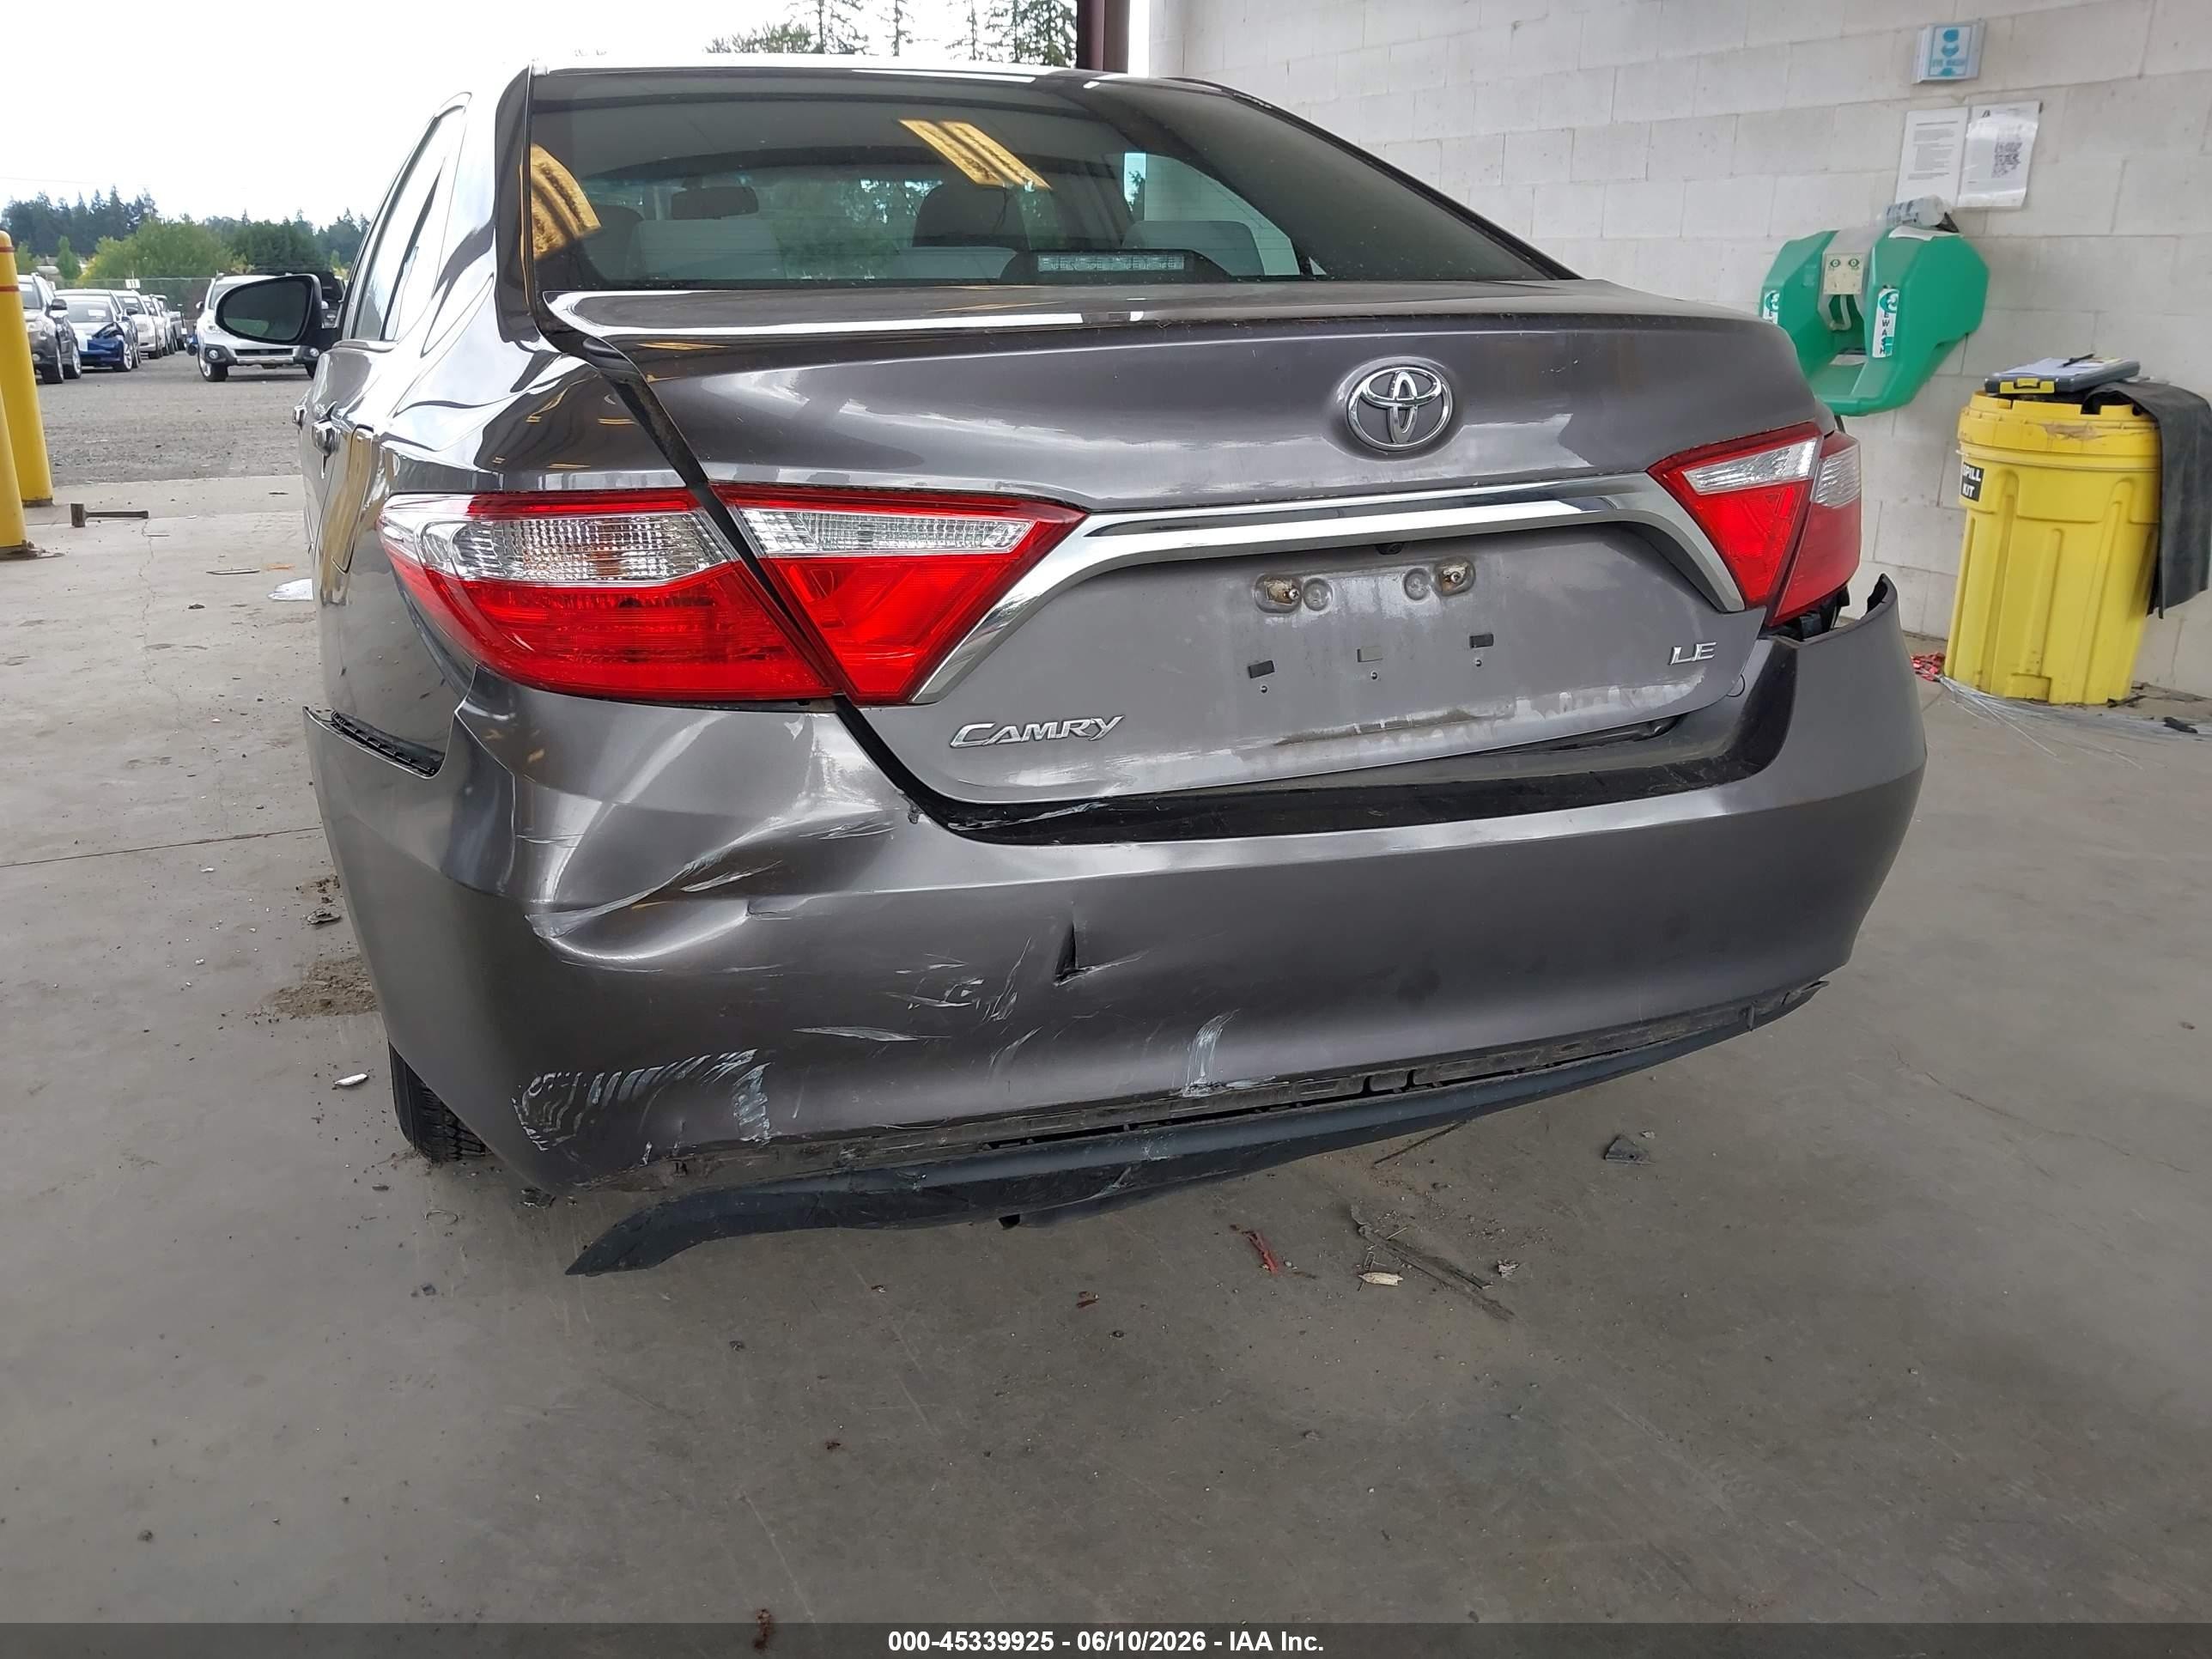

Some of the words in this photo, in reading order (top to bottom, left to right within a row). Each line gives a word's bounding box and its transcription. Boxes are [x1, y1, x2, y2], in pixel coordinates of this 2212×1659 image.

[1962, 464, 1981, 482] SPILL
[1962, 483, 1975, 497] KIT
[1668, 641, 1717, 665] LE
[950, 714, 1125, 748] CAMRY
